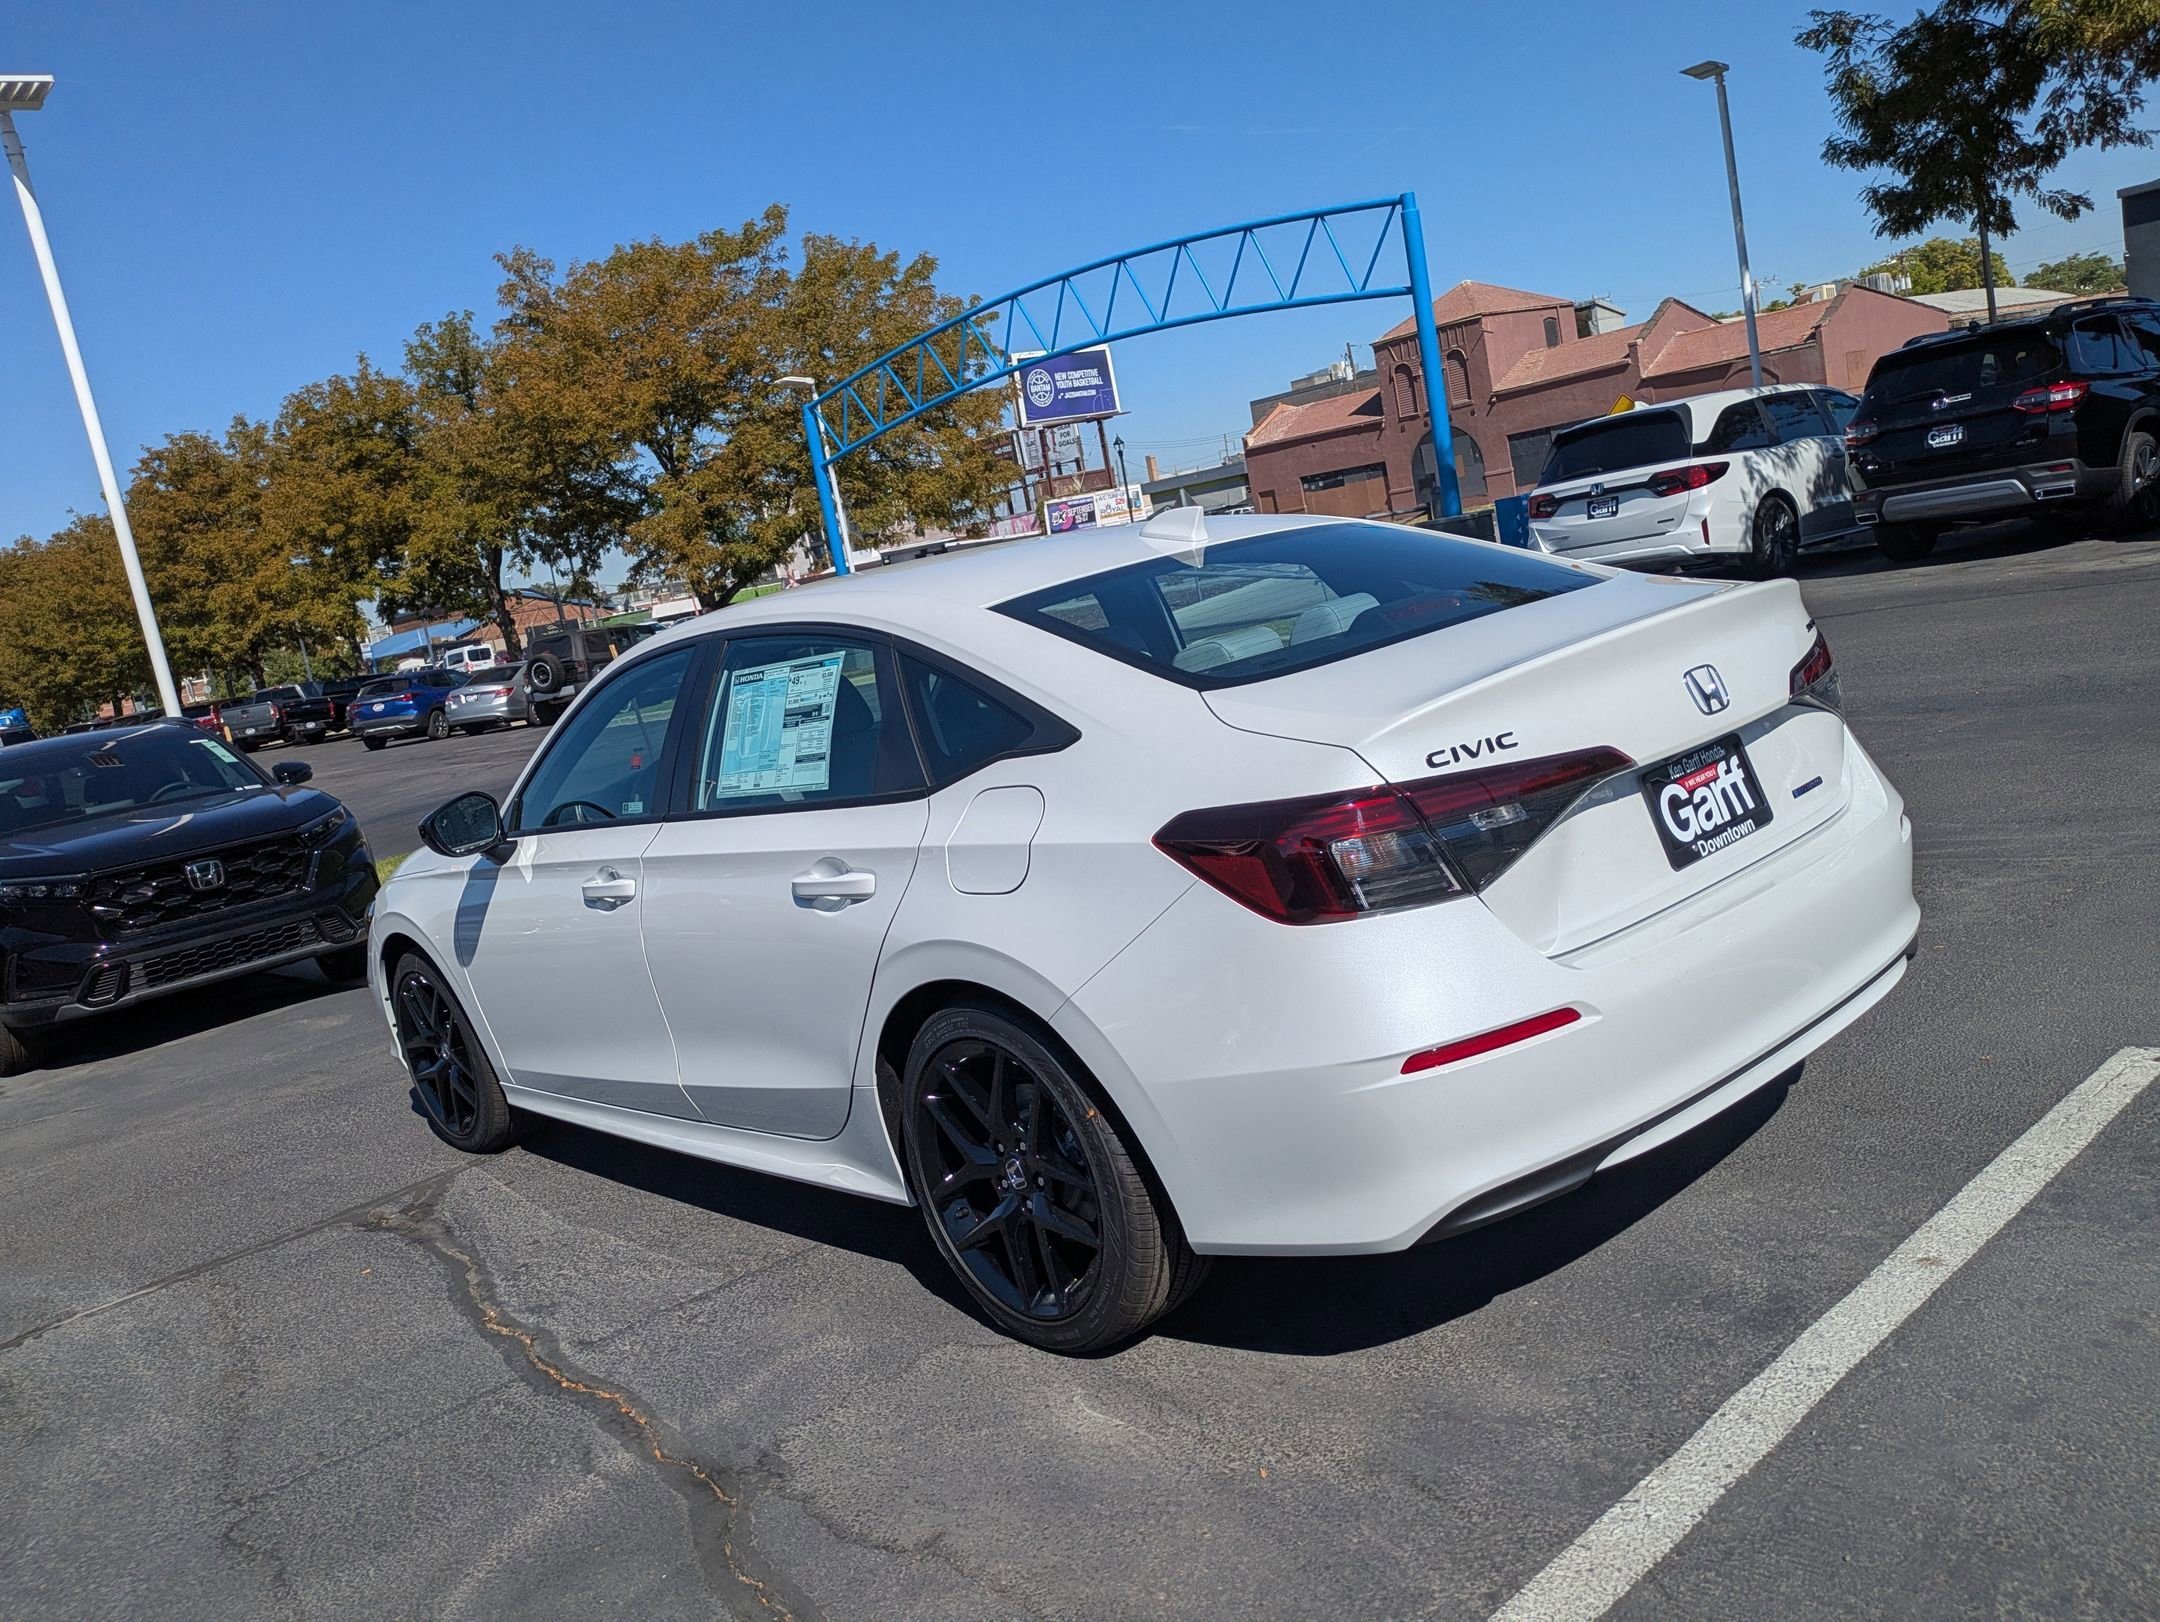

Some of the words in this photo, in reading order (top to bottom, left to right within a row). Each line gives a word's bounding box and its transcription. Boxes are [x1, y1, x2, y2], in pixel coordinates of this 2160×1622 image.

[1055, 372, 1067, 381] NEW
[1067, 368, 1099, 379] COMPETITIVE
[1056, 379, 1073, 389] YOUTH
[1073, 376, 1104, 388] BASKETBALL
[1928, 426, 1964, 445] Garff
[1100, 505, 1125, 515] ROYAL
[1590, 500, 1617, 515] Garff
[740, 673, 764, 683] HONDA
[792, 675, 800, 685] 49
[1425, 731, 1519, 769] CIVIC
[1667, 763, 1685, 780] Ken
[1682, 753, 1700, 773] Garff
[1699, 745, 1723, 764] Honda
[1660, 754, 1756, 843] Garff
[1697, 818, 1756, 857] Downtown
